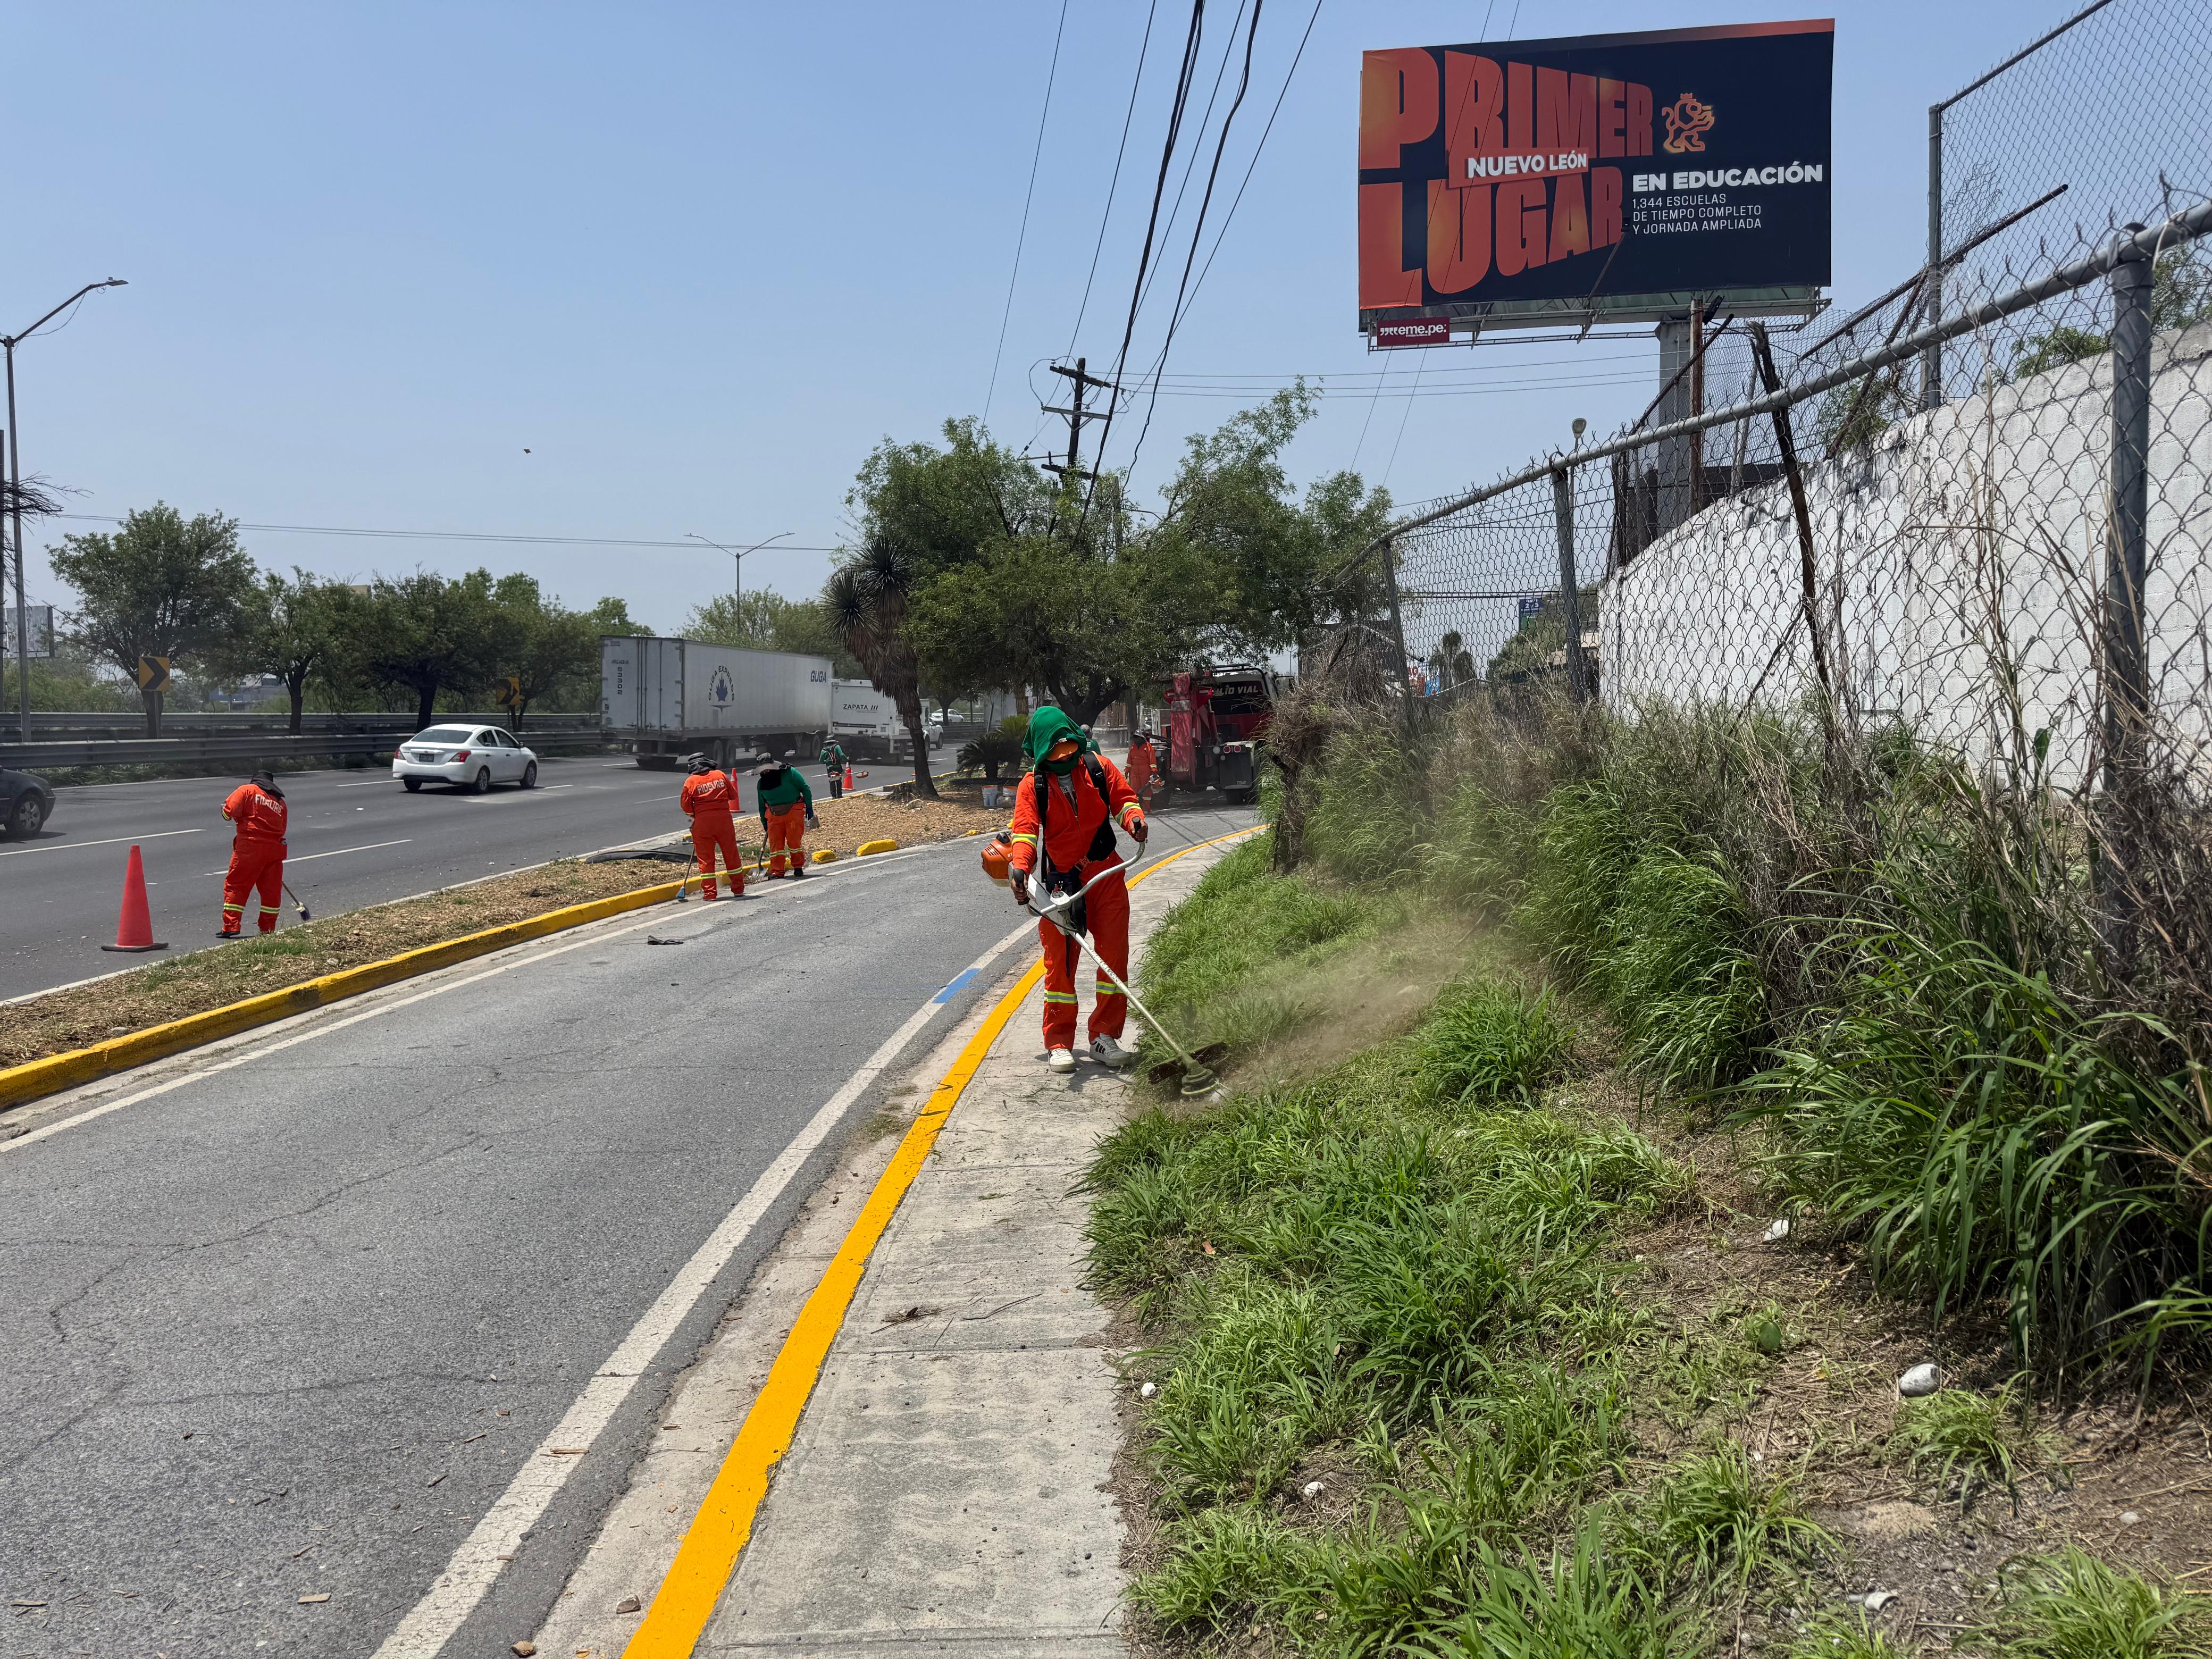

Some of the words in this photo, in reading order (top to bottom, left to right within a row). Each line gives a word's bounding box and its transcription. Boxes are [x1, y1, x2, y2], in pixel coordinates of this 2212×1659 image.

[1360, 47, 1653, 169] PRIMER
[1468, 155, 1545, 179] NUEVO
[1549, 150, 1587, 170] LEÓN
[1632, 173, 1666, 192] EN
[1673, 161, 1823, 189] EDUCACIÓN
[1632, 197, 1663, 210] 1,344
[1666, 194, 1727, 207] ESCUELAS
[1633, 211, 1648, 222] DE
[1650, 208, 1695, 221] TIEMPO
[1698, 205, 1762, 219] COMPLETO
[1632, 224, 1640, 234] Y
[1643, 221, 1698, 234] JORNADA
[1702, 218, 1762, 231] AMPLIADA
[1360, 166, 1623, 310] LUGAR
[810, 671, 826, 683] GUGA
[1237, 685, 1259, 694] VIAL
